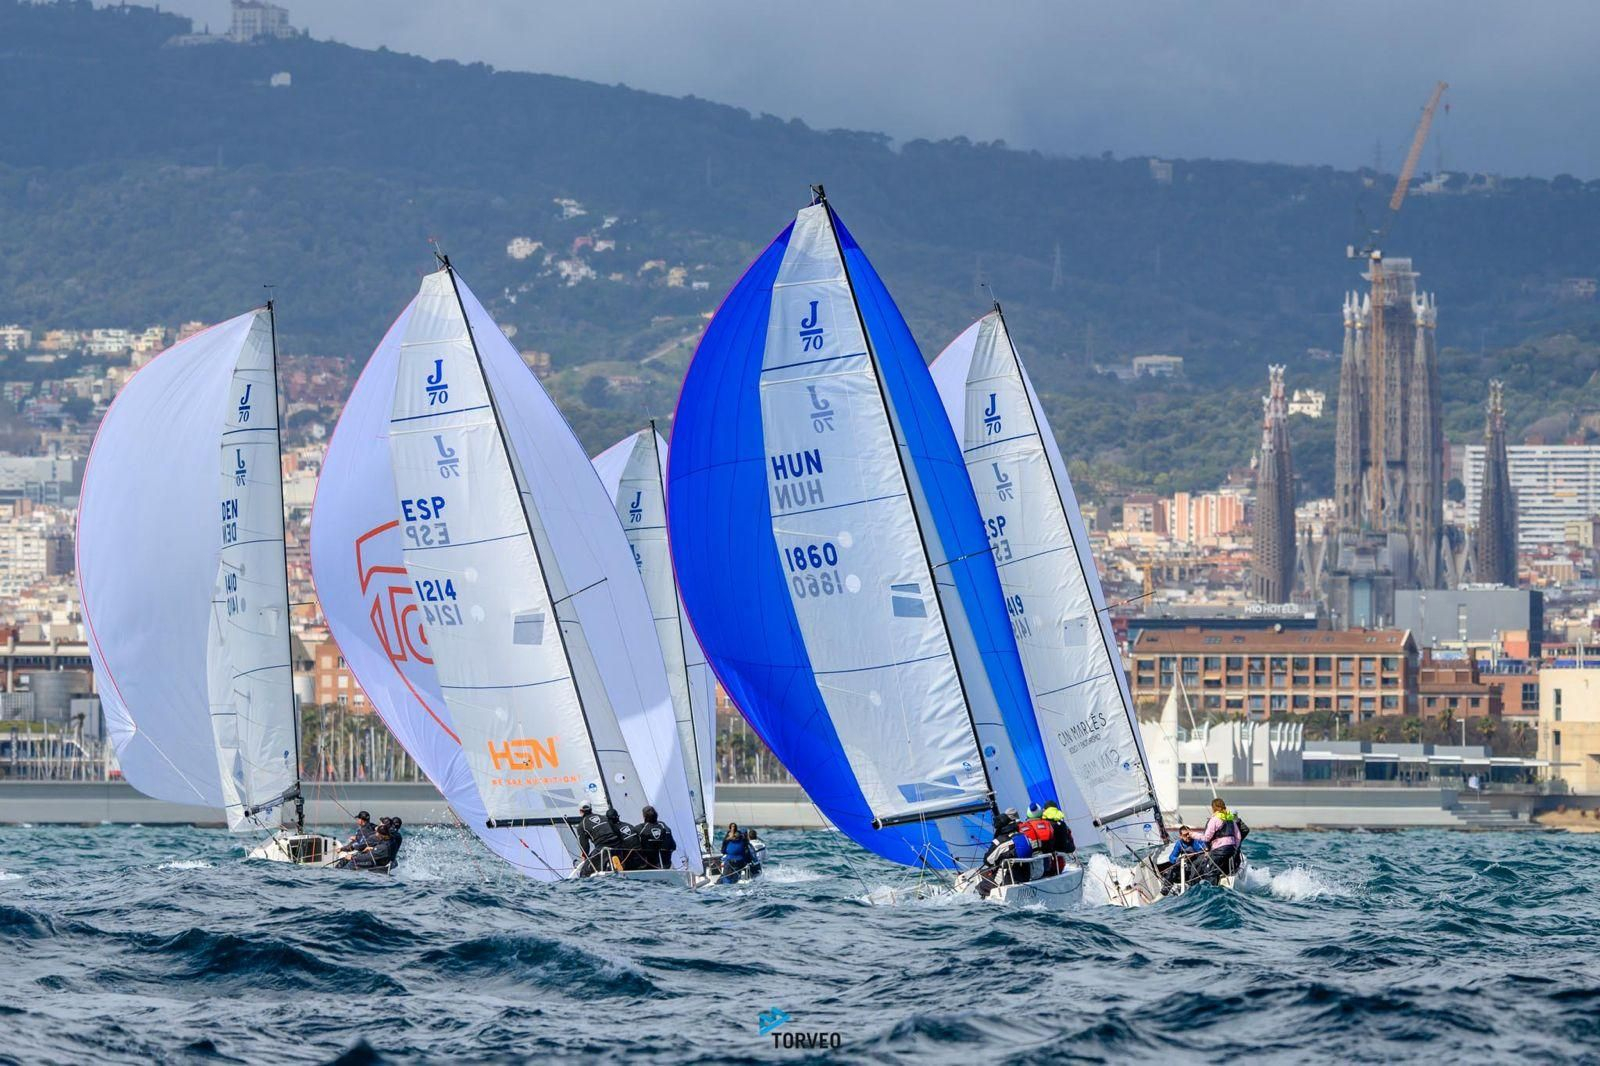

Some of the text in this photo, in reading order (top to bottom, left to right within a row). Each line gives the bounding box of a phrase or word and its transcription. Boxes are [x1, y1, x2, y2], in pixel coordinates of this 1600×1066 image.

[801, 301, 819, 329] J
[802, 335, 823, 352] 70
[427, 359, 443, 385] J
[240, 384, 252, 405] J
[428, 390, 448, 405] 70
[985, 393, 996, 417] J
[238, 411, 250, 423] 70
[986, 421, 1001, 436] 70
[771, 449, 824, 480] HUN
[222, 499, 238, 521] DEN
[401, 496, 446, 522] ESP
[631, 491, 641, 508] J
[630, 513, 642, 523] 70
[983, 515, 1006, 540] SP
[785, 542, 838, 572] 1860
[415, 579, 457, 602] 1214
[1006, 594, 1024, 617] 419
